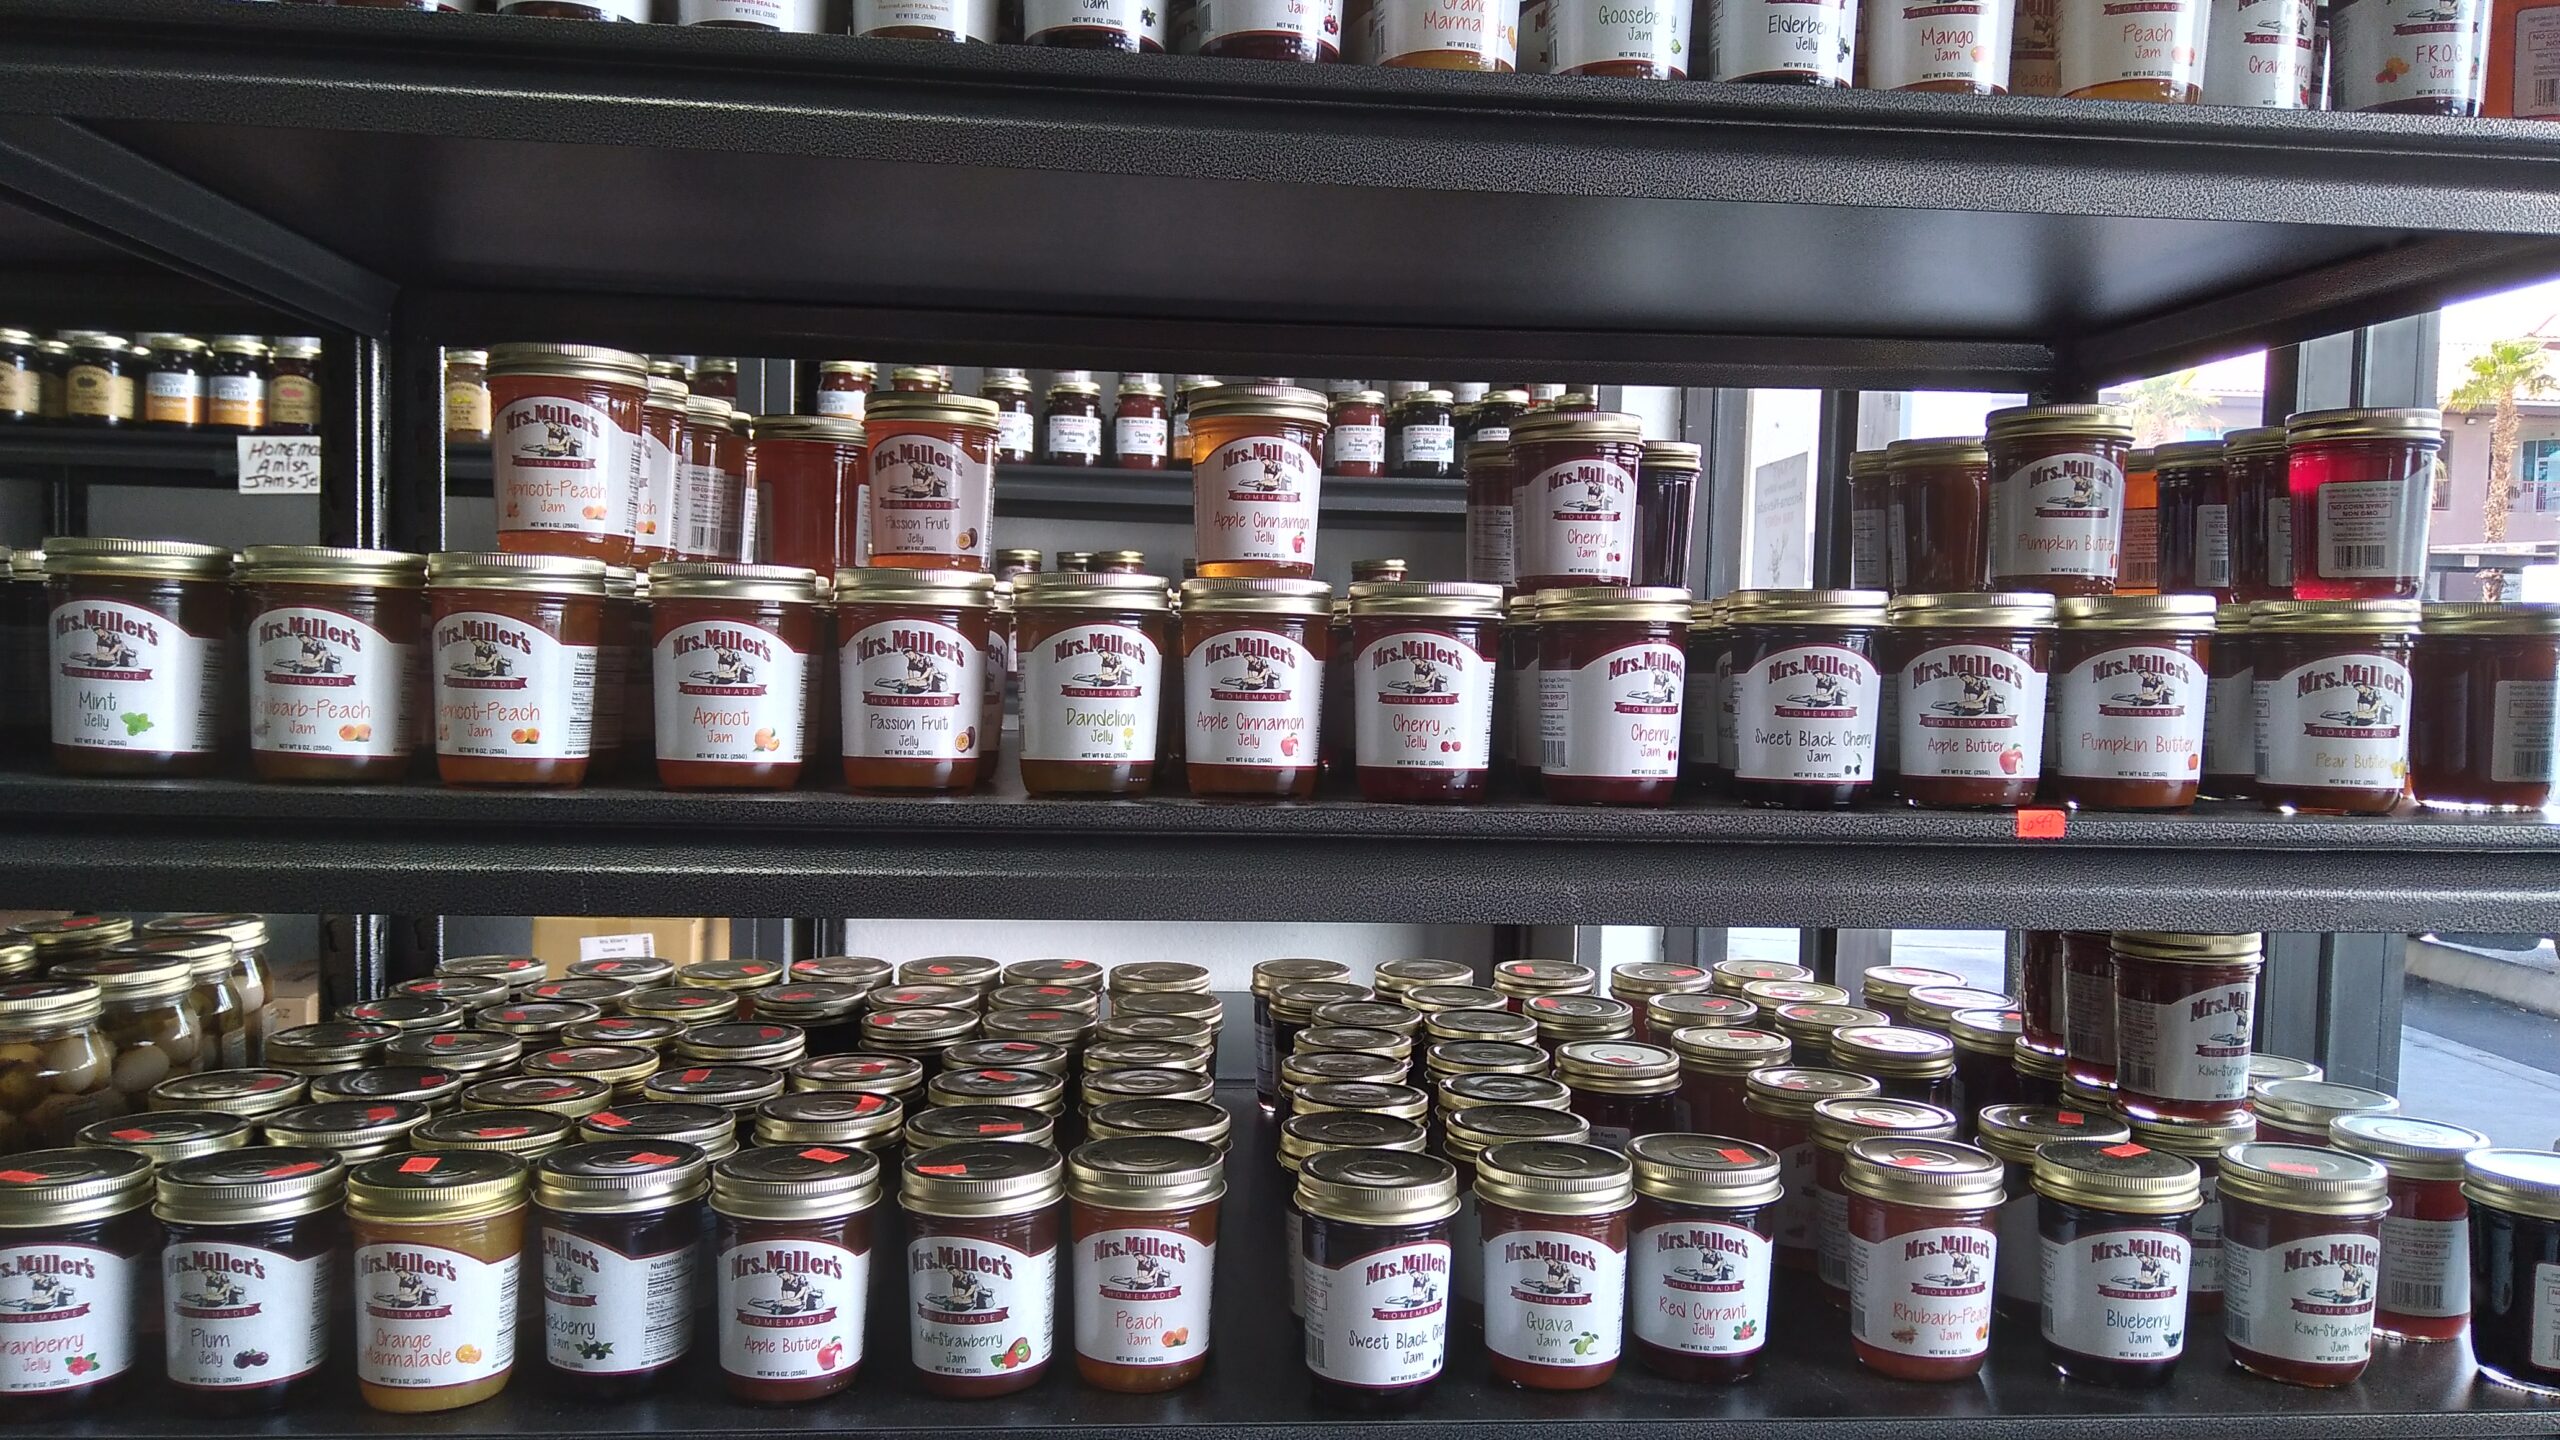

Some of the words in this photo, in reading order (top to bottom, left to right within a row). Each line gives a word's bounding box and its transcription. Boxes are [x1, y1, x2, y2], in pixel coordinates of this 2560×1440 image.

[1628, 26, 1652, 41] Jam
[1921, 26, 1974, 51] Mango
[2124, 24, 2174, 43] Peach
[1795, 37, 1818, 54] Jelly
[2134, 46, 2161, 59] Jam
[1934, 47, 1961, 62] Jam
[2430, 66, 2455, 80] Jam
[540, 500, 566, 513] Jam
[925, 516, 949, 530] Fruit
[1214, 511, 1246, 532] Apple
[1253, 511, 1310, 529] Cinnamon
[907, 532, 924, 545] Jelly
[1254, 530, 1275, 546] Jelly
[1567, 528, 1607, 548] Cherry
[2018, 534, 2077, 555] Pumpkin
[1576, 546, 1597, 558] Jam
[687, 686, 758, 696] HOMEMADE
[1070, 689, 1136, 697] HOMEMADE
[78, 691, 116, 712] Mint
[871, 696, 949, 706] HOMEMADE
[1386, 696, 1450, 704] HOMEMADE
[84, 712, 109, 731] Jelly
[693, 706, 750, 727] Apricot
[1066, 708, 1136, 726] Dandelion
[1197, 711, 1228, 732] Apple
[1236, 712, 1305, 731] Cinnamon
[1784, 710, 1851, 718] HOMEMADE
[288, 721, 316, 734] Jam
[870, 713, 915, 731] Passion
[921, 714, 949, 731] Fruit
[1393, 713, 1440, 736] Cherry
[1926, 719, 2006, 728] HOMEMADE
[467, 723, 493, 738] Jam
[707, 730, 733, 743] Jam
[1091, 729, 1113, 745] Jelly
[1631, 723, 1670, 745] Cherry
[2315, 727, 2394, 738] HOMEMADE
[899, 734, 919, 749] Jelly
[1237, 733, 1260, 749] Jelly
[1404, 735, 1427, 751] Jelly
[1755, 728, 1792, 746] Sweet
[1799, 730, 1836, 747] Black
[1843, 730, 1872, 749] Cherry
[1928, 737, 1959, 755] Apple
[1966, 738, 2005, 753] Butter
[2081, 732, 2148, 755] Pumpkin
[2156, 736, 2194, 753] Butter
[1640, 745, 1661, 757] Jam
[1807, 750, 1831, 763] Jam
[2315, 752, 2346, 769] Pear
[1672, 1281, 1737, 1292] HOMEMADE
[1921, 1288, 1982, 1296] HOMEMADE
[1107, 1291, 1173, 1300] HOMEMADE
[1517, 1293, 1584, 1305] HOMEMADE
[2109, 1290, 2172, 1299] HOMEMADE
[1659, 1296, 1686, 1318] Red
[1694, 1302, 1747, 1321] Currant
[743, 1315, 825, 1327] HOMEMADE
[1115, 1310, 1162, 1330] Peach
[1526, 1311, 1574, 1332] Guava
[2106, 1309, 2171, 1331] Blueberry
[191, 1327, 230, 1348] Plum
[1692, 1322, 1716, 1338] Jelly
[1939, 1328, 1962, 1341] Jam
[2128, 1331, 2152, 1344] Jam
[375, 1328, 431, 1354] Orange
[744, 1335, 776, 1354] Apple
[782, 1337, 823, 1352] Butter
[1127, 1332, 1152, 1345] Jam
[1349, 1329, 1389, 1350] Sweet
[1396, 1331, 1427, 1349] Black
[1536, 1334, 1562, 1347] Jam
[2330, 1342, 2350, 1354] Jam
[22, 1357, 51, 1373] Jelly
[199, 1351, 223, 1367] Jelly
[365, 1348, 451, 1368] Marmalade
[945, 1351, 967, 1364] Jam
[1403, 1351, 1424, 1365] Jam
